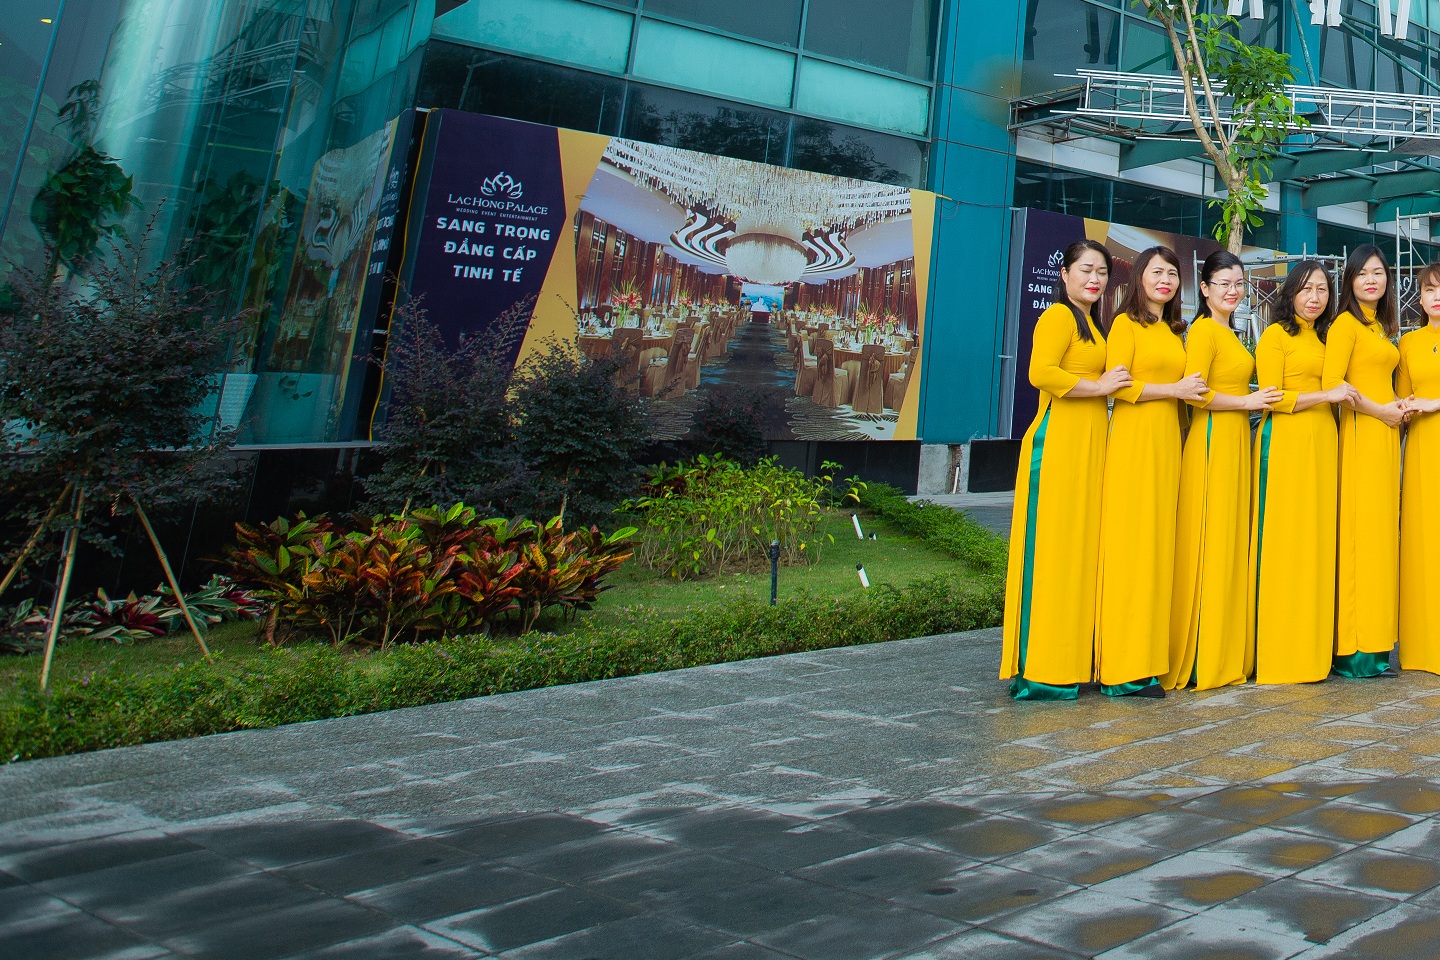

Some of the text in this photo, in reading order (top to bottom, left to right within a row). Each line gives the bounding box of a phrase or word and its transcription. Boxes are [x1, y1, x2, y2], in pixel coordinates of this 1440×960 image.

[448, 194, 549, 215] LAC HONG PALACE
[436, 217, 551, 241] SANG TRỌNG
[444, 237, 537, 261] ĐẲNG CẤP
[453, 264, 524, 283] TINH TẾ
[1028, 283, 1053, 294] SANG
